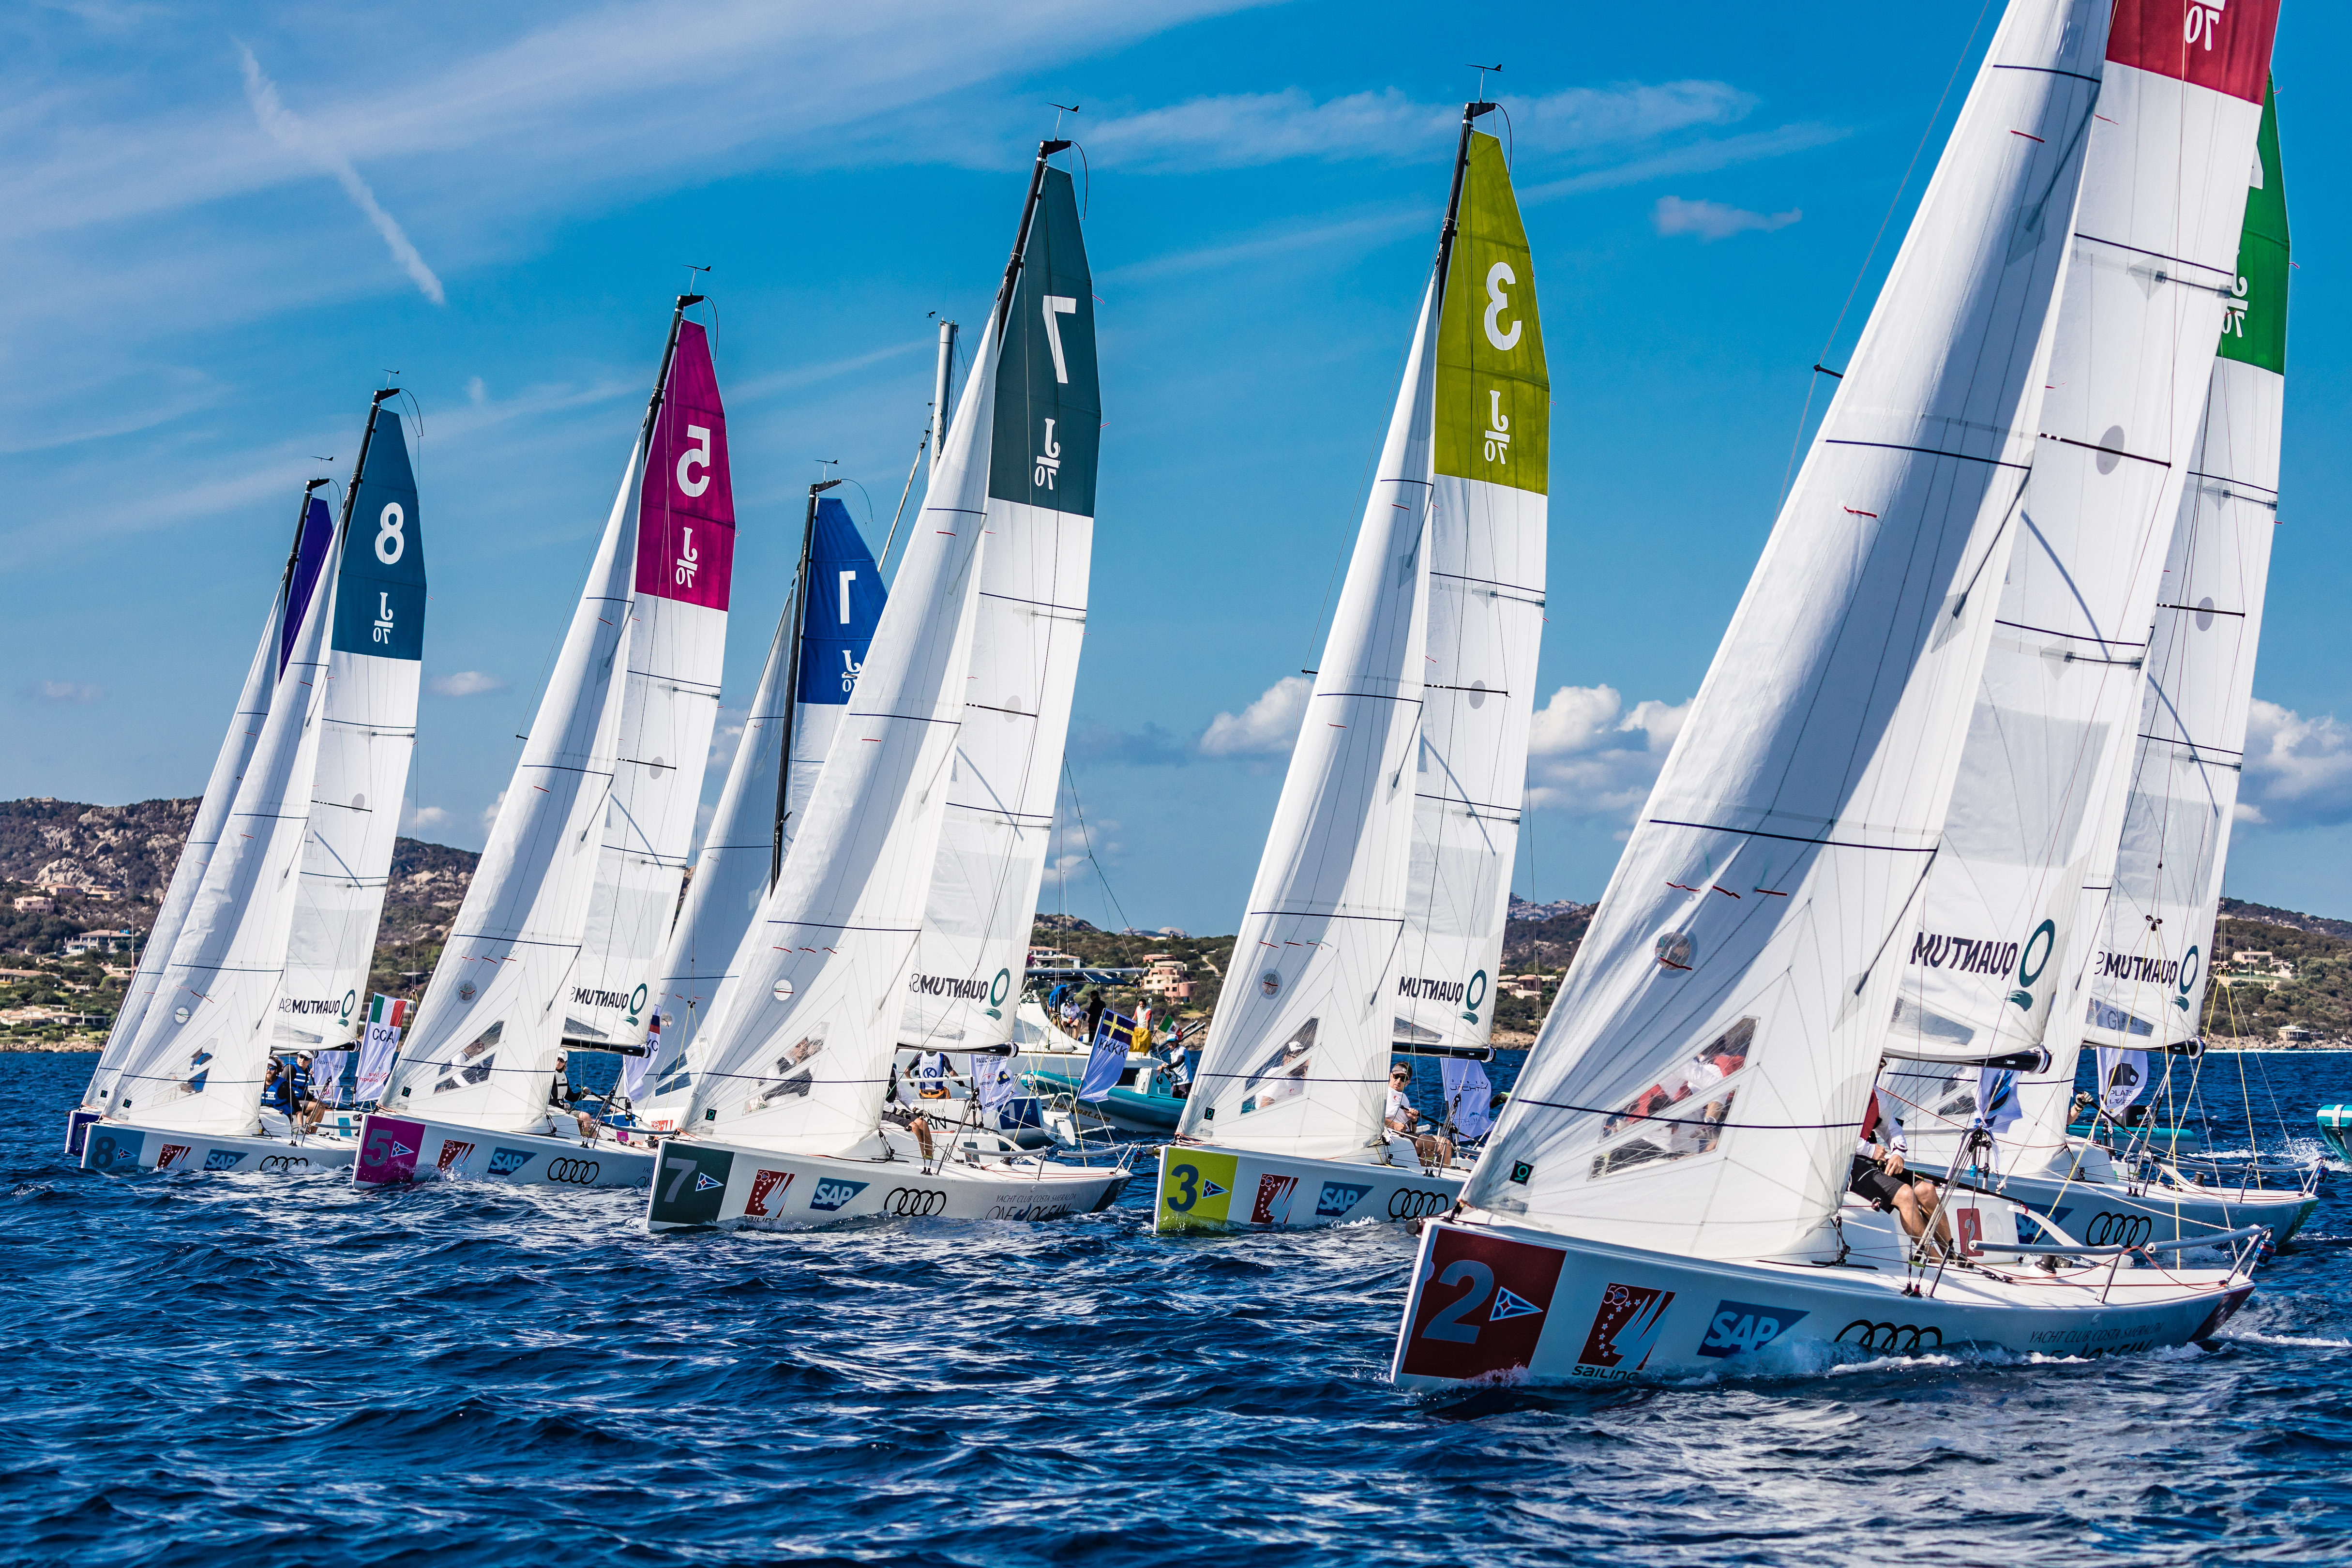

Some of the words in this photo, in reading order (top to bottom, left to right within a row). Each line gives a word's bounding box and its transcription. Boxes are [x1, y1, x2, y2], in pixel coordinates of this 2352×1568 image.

[373, 1028, 394, 1044] CCA
[1098, 1038, 1128, 1058] KKKK
[91, 1136, 116, 1169] 8
[363, 1129, 393, 1167] 5
[206, 1154, 237, 1169] SAP
[489, 1152, 524, 1171] SAP
[664, 1157, 697, 1203] 7
[1167, 1163, 1199, 1212] 3
[813, 1183, 854, 1207] SAP
[1050, 1193, 1077, 1202] SMERALDA
[1318, 1188, 1358, 1210] SAP
[1421, 1260, 1494, 1344] 2
[1704, 1311, 1779, 1351] SAP
[2029, 1331, 2066, 1343] YACHT
[2065, 1330, 2092, 1342] CLUB
[2092, 1328, 2121, 1342] COSTA
